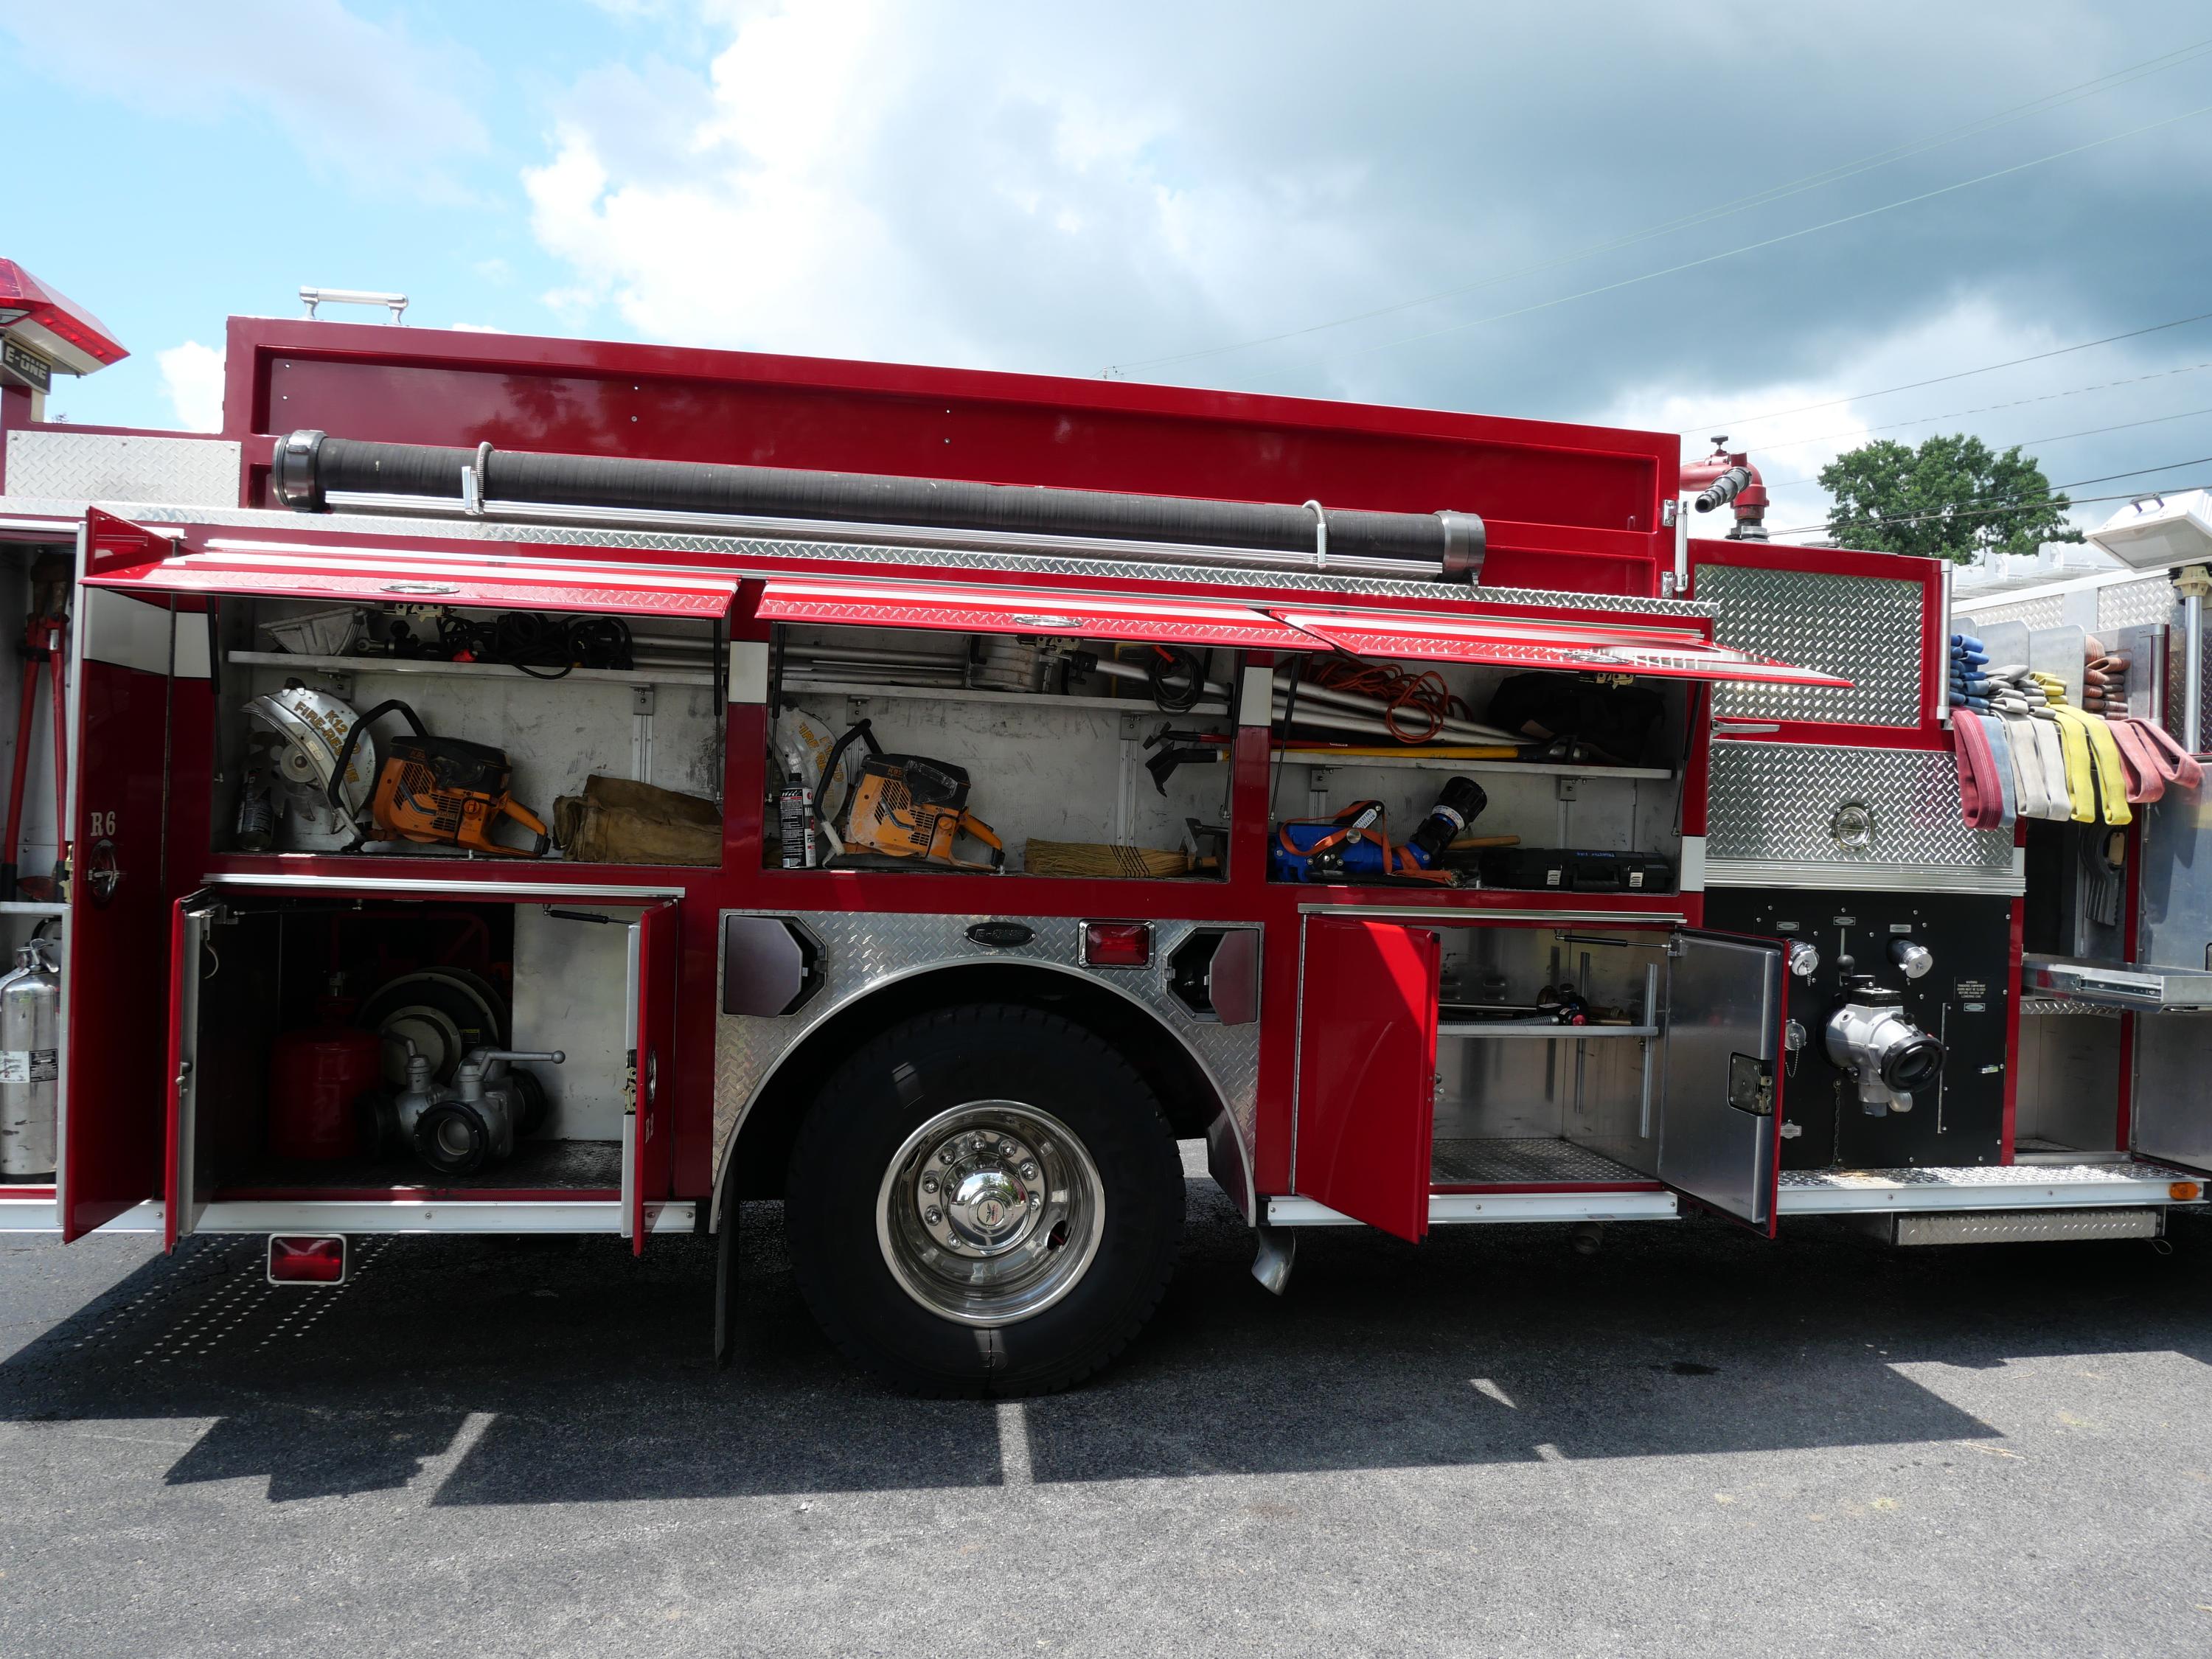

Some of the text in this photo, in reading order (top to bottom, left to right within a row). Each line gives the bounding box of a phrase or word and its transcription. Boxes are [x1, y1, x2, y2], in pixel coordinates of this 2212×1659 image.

[324, 709, 349, 736] K12
[293, 700, 360, 785] FIRE-RESUE
[90, 811, 116, 837] R6
[645, 1112, 654, 1144] R2
